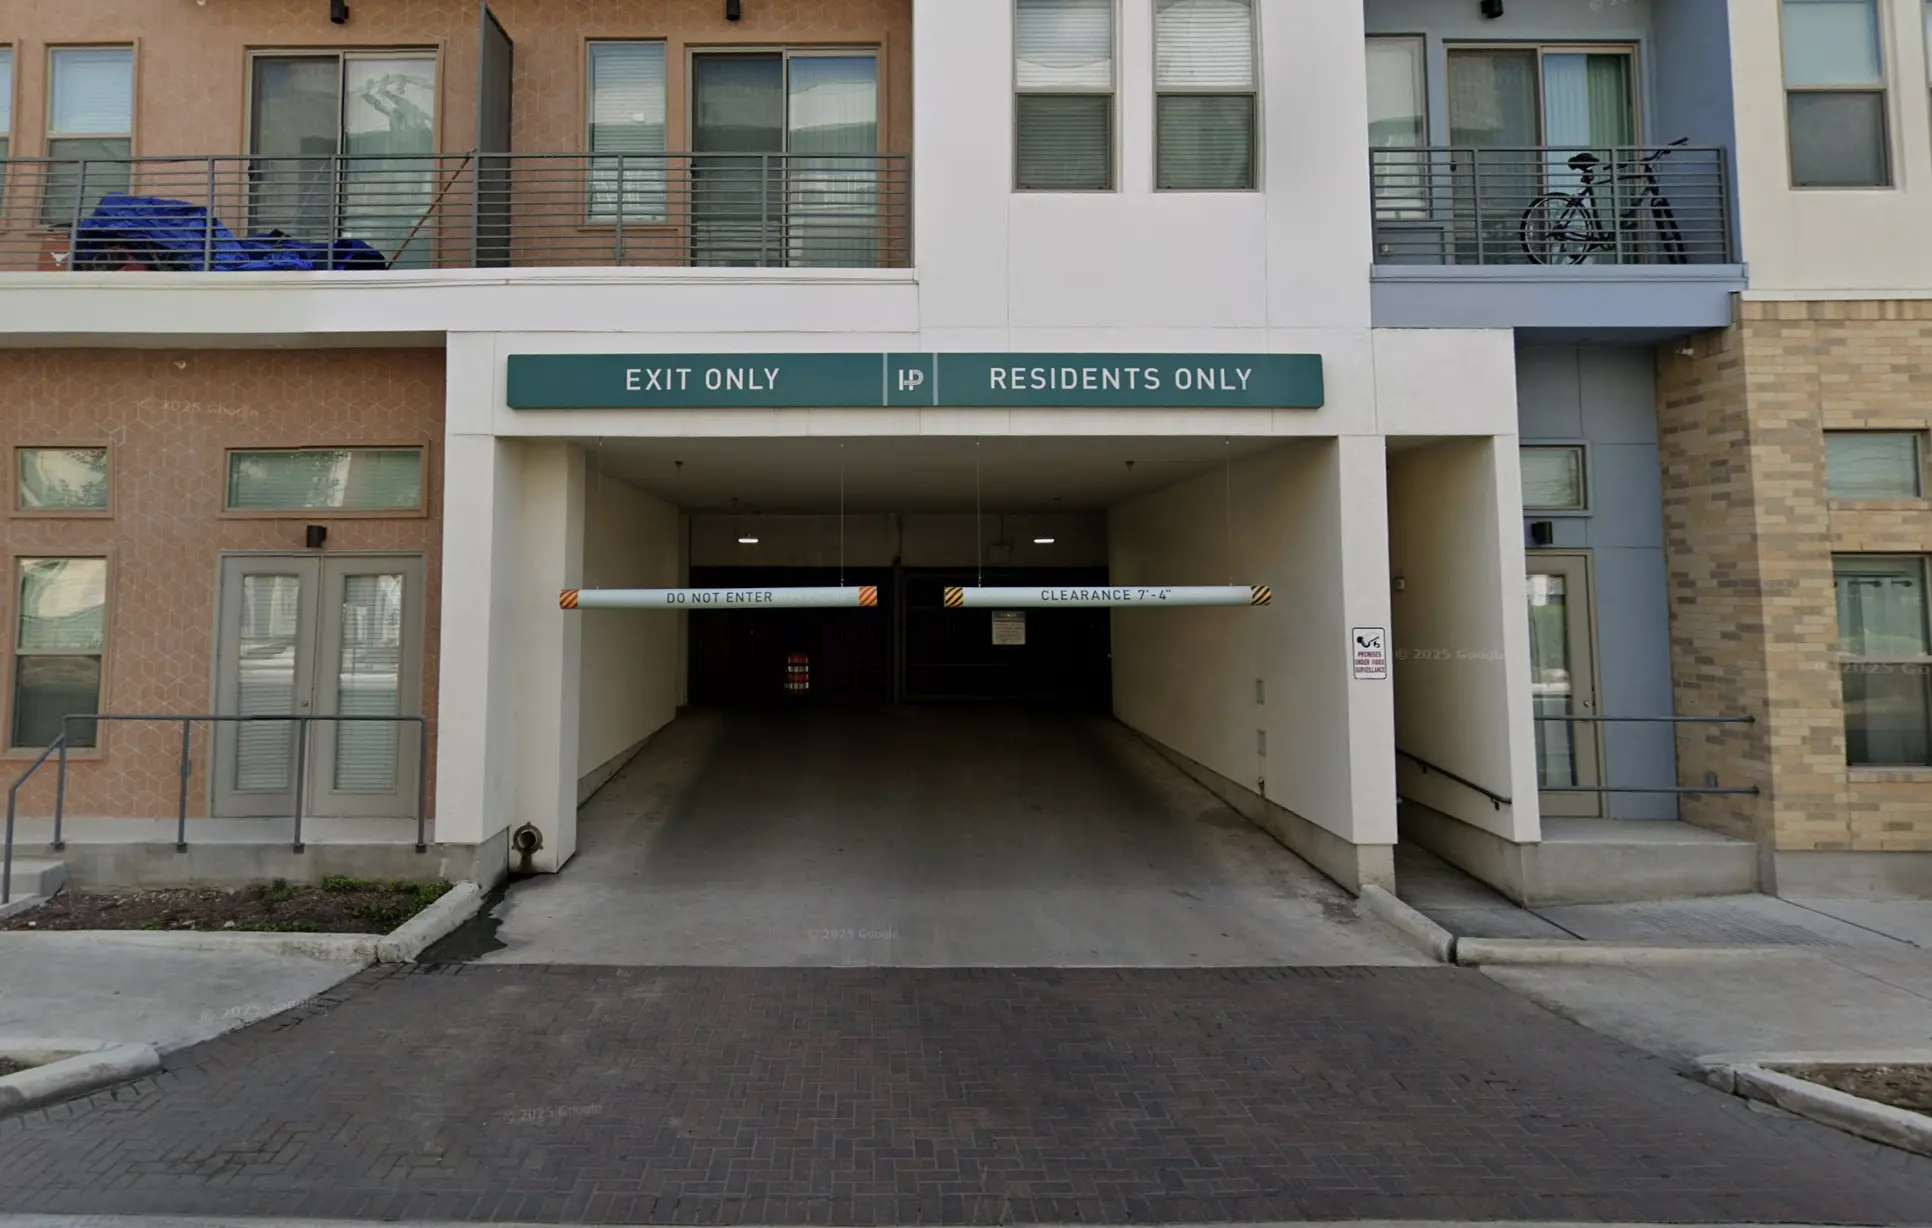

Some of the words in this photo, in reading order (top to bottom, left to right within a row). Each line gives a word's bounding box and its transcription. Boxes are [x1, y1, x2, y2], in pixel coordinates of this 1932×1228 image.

[625, 368, 692, 391] EXIT
[705, 368, 780, 390] ONLY
[989, 367, 1160, 390] RESIDENTS
[1175, 367, 1253, 390] ONLY
[666, 592, 686, 604] DO
[691, 592, 720, 604] NOT
[726, 591, 773, 603] ENTER
[1040, 589, 1132, 601] CLEARANCE
